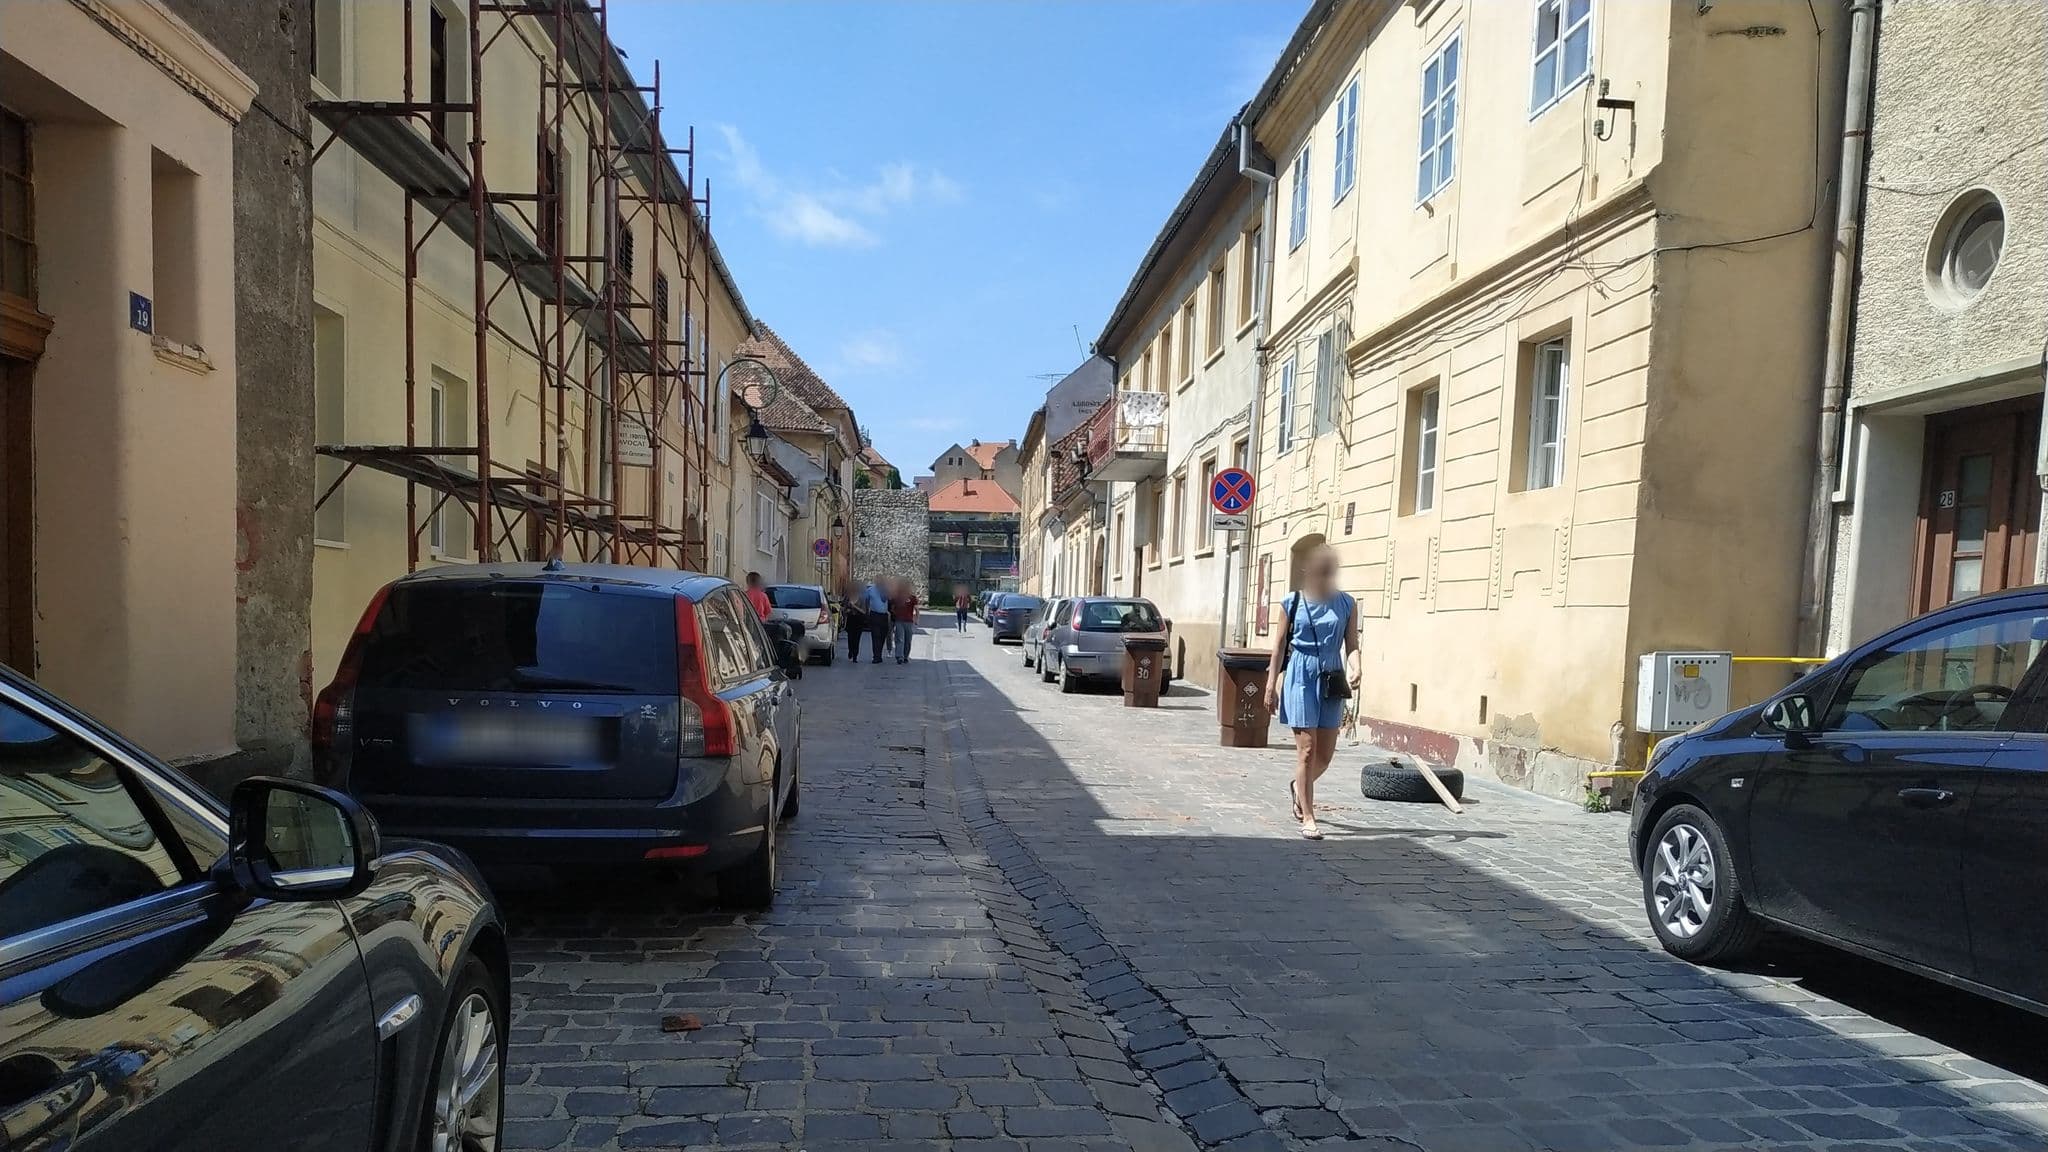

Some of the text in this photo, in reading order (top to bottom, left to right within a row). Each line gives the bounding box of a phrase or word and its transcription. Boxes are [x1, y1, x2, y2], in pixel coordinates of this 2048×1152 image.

[137, 310, 149, 327] 19
[1940, 493, 1953, 507] 28
[1137, 667, 1149, 680] 30
[448, 698, 583, 709] VOLVO
